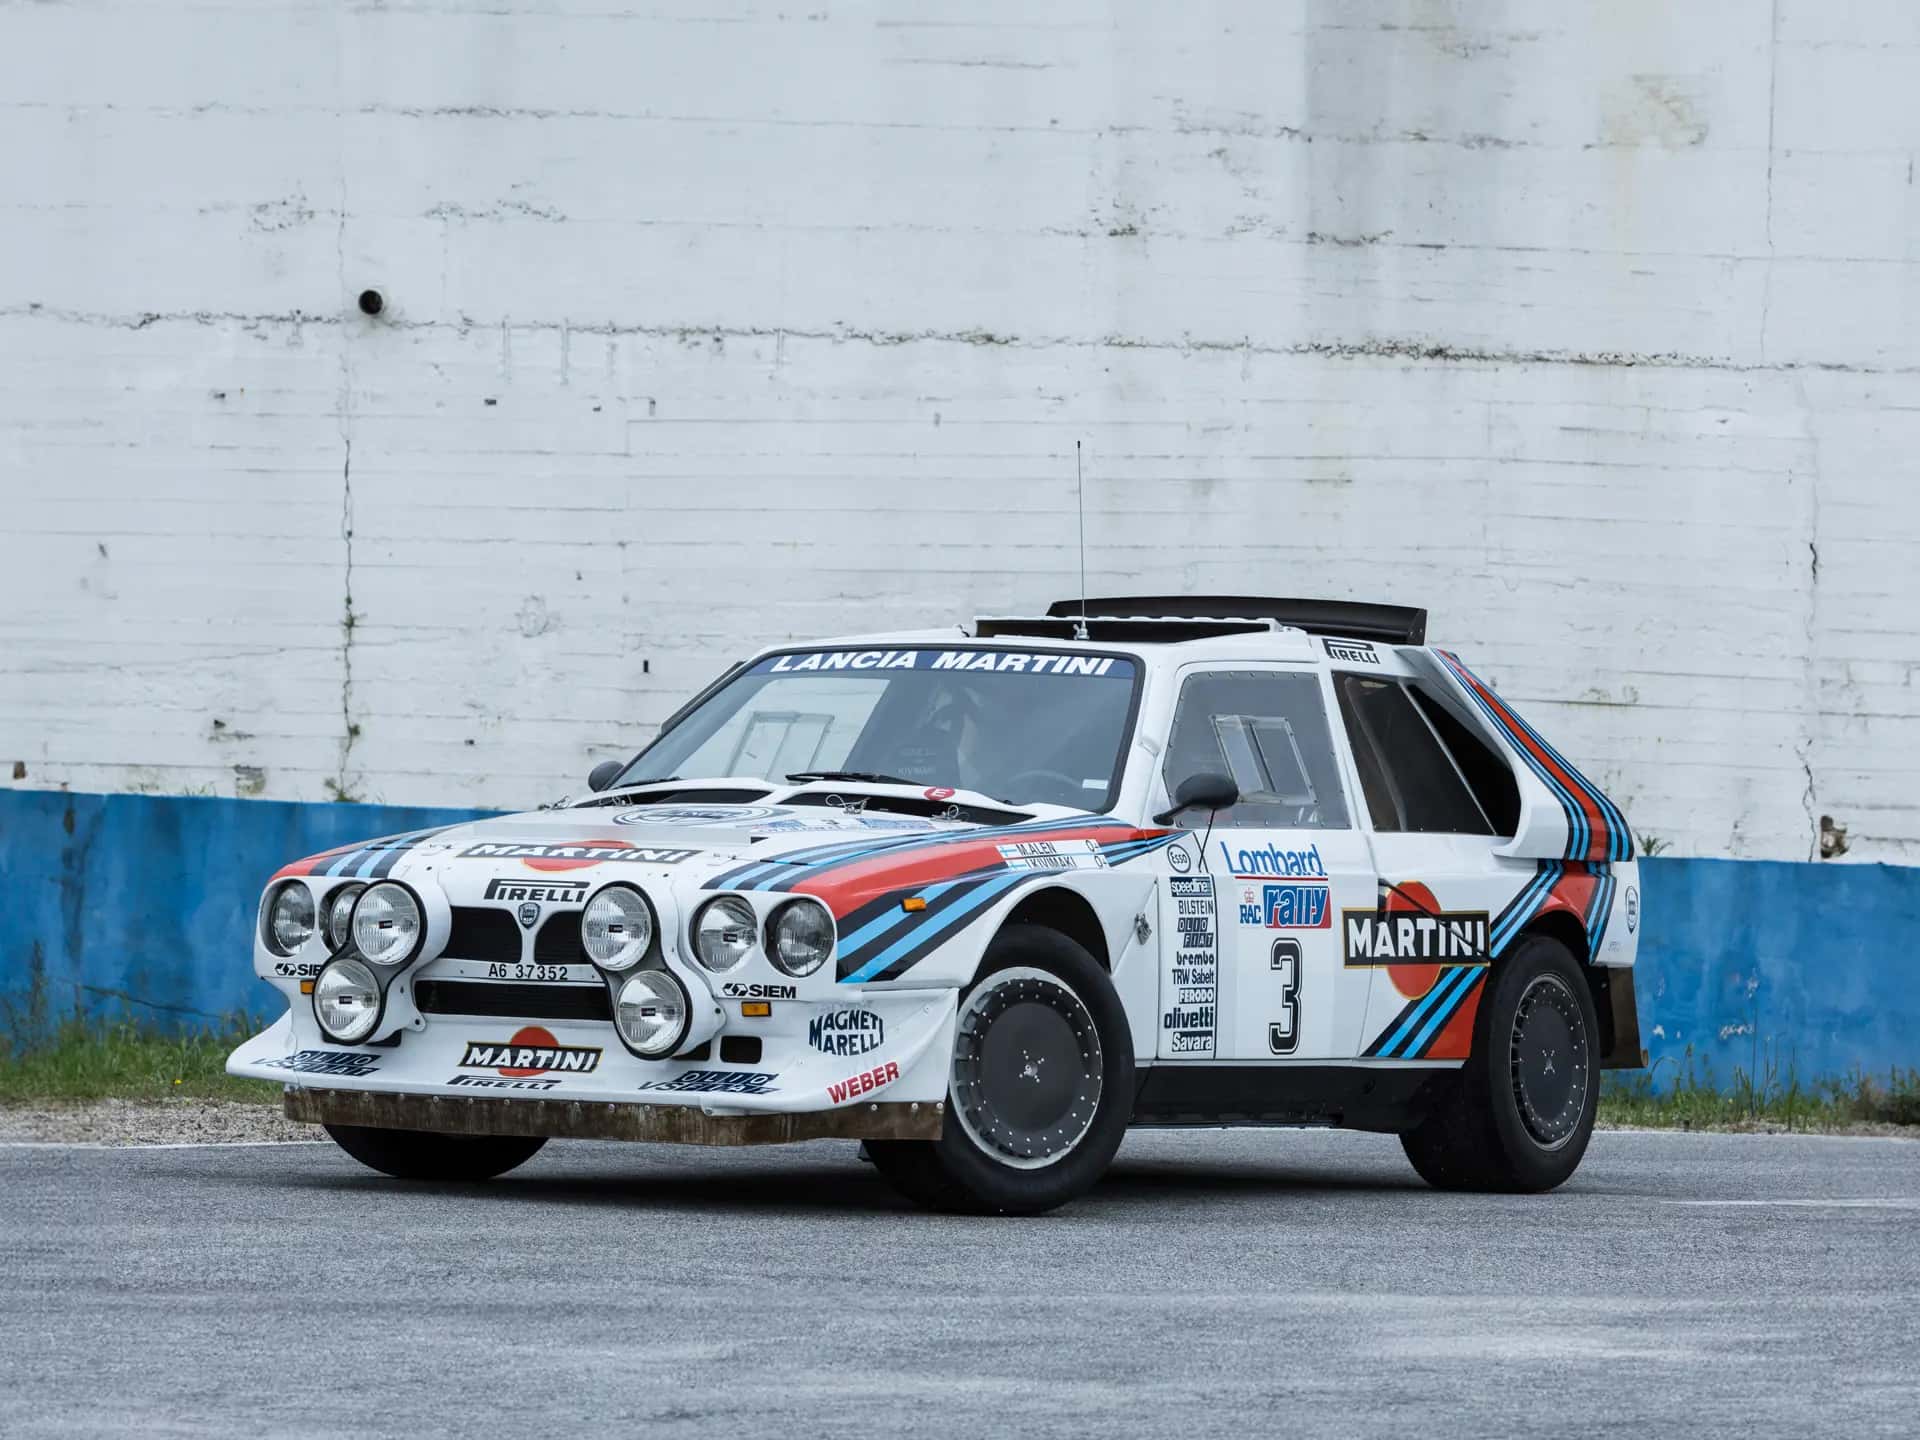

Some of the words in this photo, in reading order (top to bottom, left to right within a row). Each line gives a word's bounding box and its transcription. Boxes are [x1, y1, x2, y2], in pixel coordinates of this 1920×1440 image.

[1321, 638, 1381, 665] PIRELLI
[769, 650, 916, 673] LANCIA
[930, 651, 1115, 676] MARTINI
[467, 843, 692, 862] MARTINI
[1169, 851, 1188, 865] Esso
[483, 878, 591, 903] PIRELLI
[1178, 900, 1214, 915] BILSTEIN
[1239, 904, 1262, 924] RAC
[1265, 887, 1329, 927] rally
[1178, 918, 1208, 932] OLIO
[1184, 933, 1213, 948] FIAT
[1347, 917, 1485, 958] MARTINI
[1176, 951, 1215, 966] brembo
[297, 963, 322, 977] SIE
[488, 963, 507, 978] A6
[515, 964, 568, 981] 37352
[1172, 968, 1190, 985] TRW
[1191, 968, 1215, 985] Sabelt
[748, 983, 797, 999] SIEM
[1179, 987, 1214, 1004] FERODO
[1268, 937, 1302, 1055] 3
[808, 1009, 884, 1042] MAGNETI
[1163, 1005, 1214, 1029] olivetti
[808, 1025, 884, 1056] MARELLI
[1171, 1031, 1213, 1052] Savara
[294, 1052, 373, 1066] OLIO
[465, 1047, 597, 1072] MARTINI
[446, 1074, 563, 1090] PIRELLI
[679, 1072, 772, 1085] OLIO
[826, 1061, 900, 1105] WEBER
